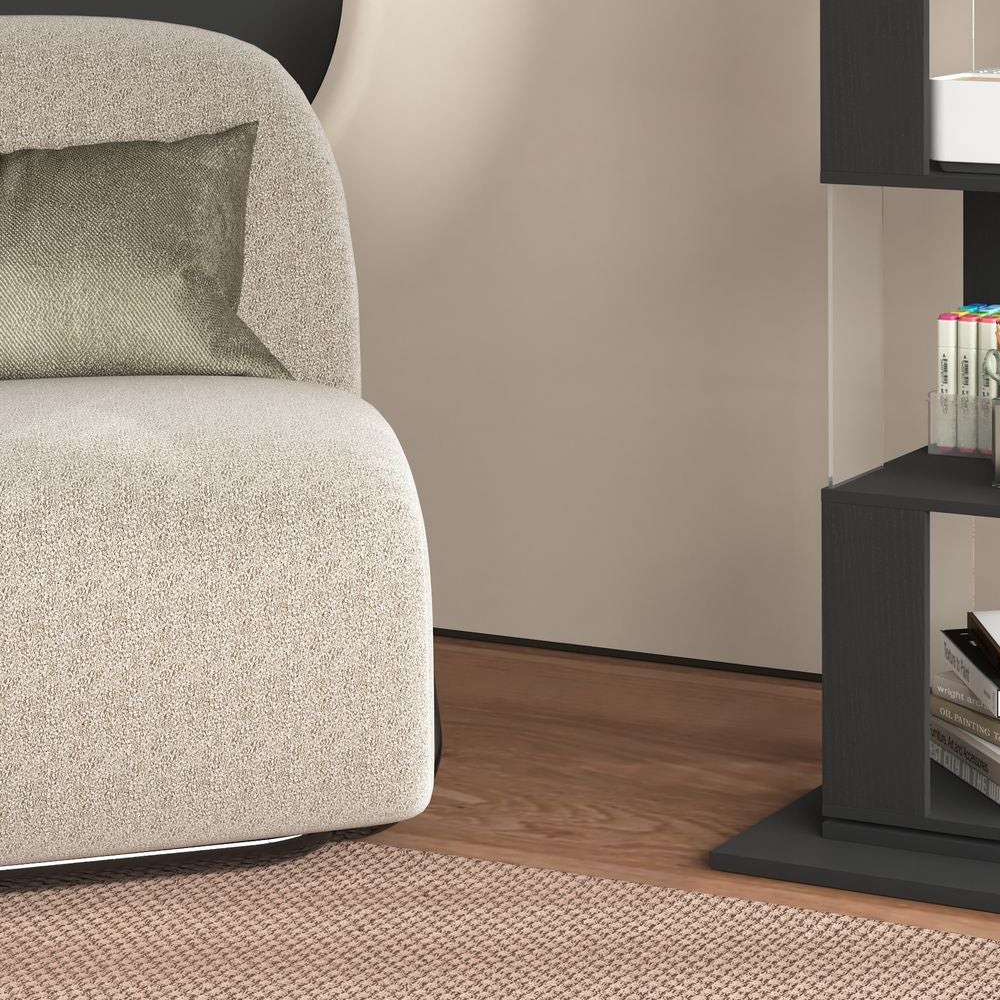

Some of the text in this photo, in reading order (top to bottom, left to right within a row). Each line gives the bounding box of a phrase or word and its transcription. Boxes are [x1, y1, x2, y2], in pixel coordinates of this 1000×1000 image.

[937, 685, 965, 700] wright
[940, 706, 953, 719] OIL
[954, 713, 991, 736] PAINTING
